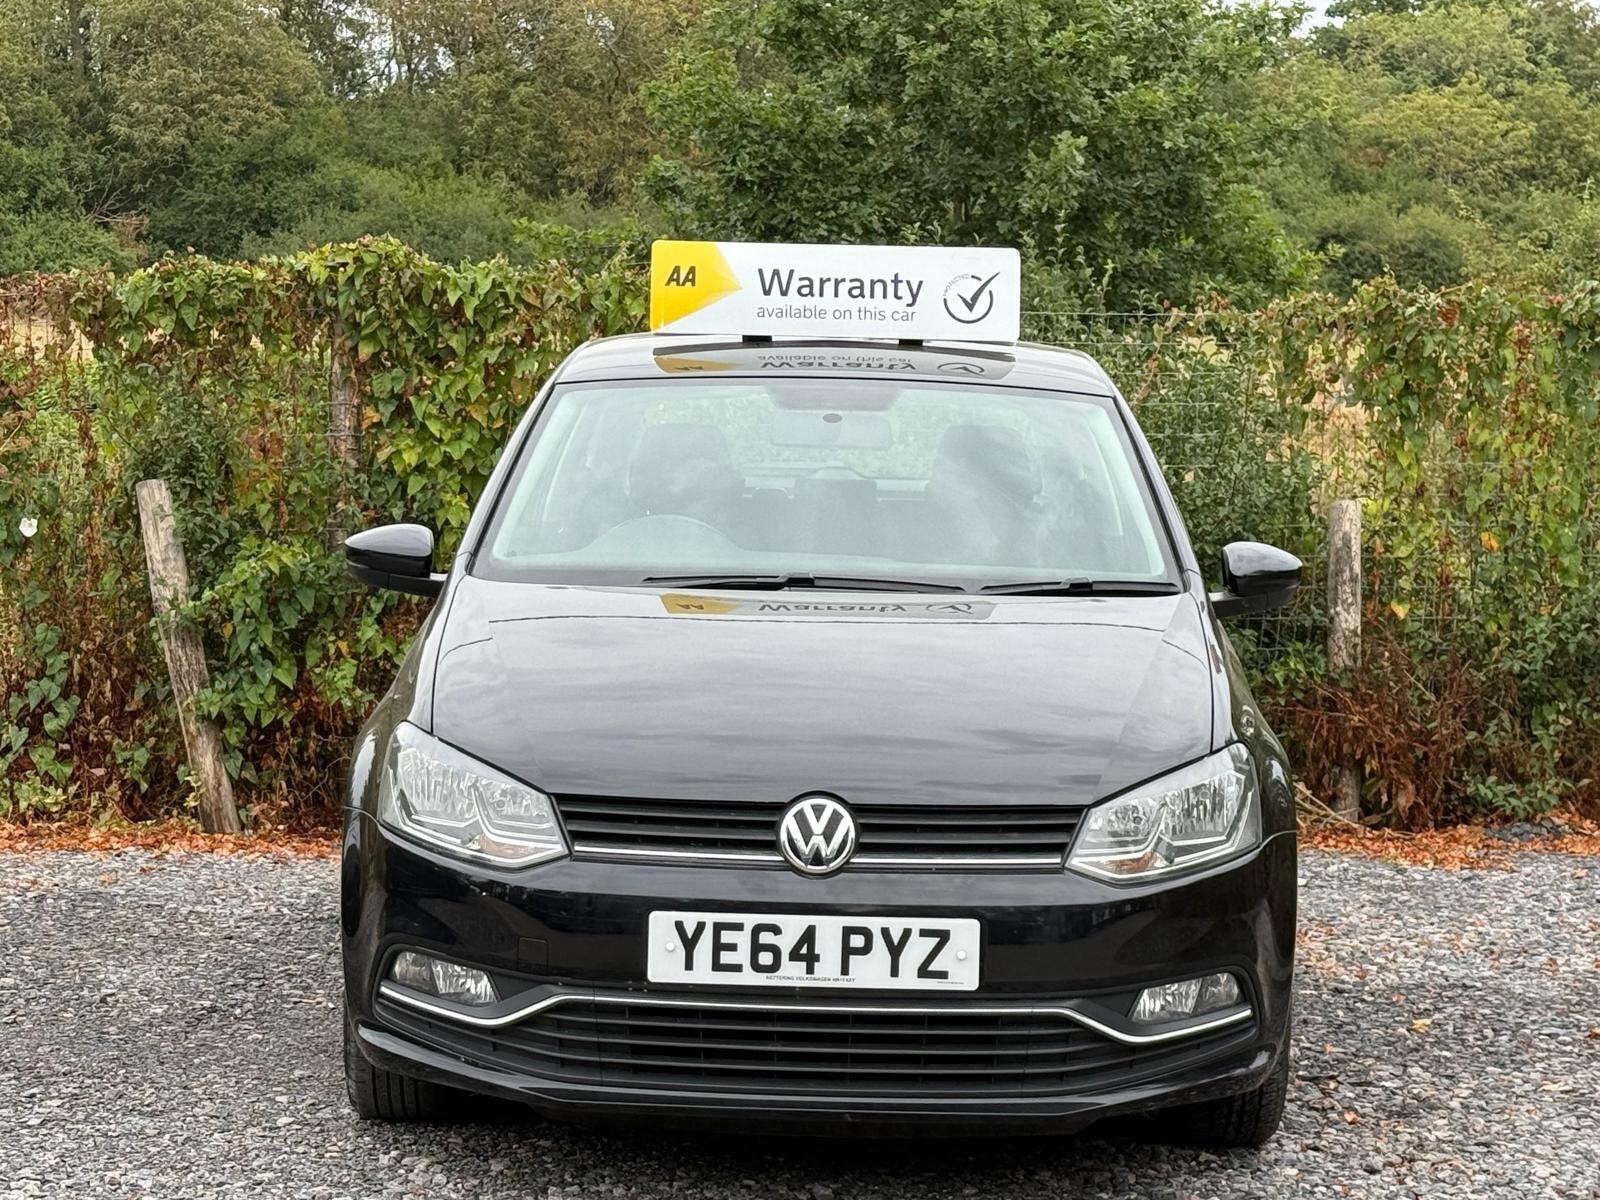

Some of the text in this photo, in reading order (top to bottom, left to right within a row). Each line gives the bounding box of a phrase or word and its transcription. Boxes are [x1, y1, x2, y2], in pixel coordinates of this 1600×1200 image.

[665, 265, 696, 286] AA
[757, 268, 923, 307] Warranty
[757, 305, 916, 322] available on this car
[675, 920, 950, 979] YE64 PYZ
